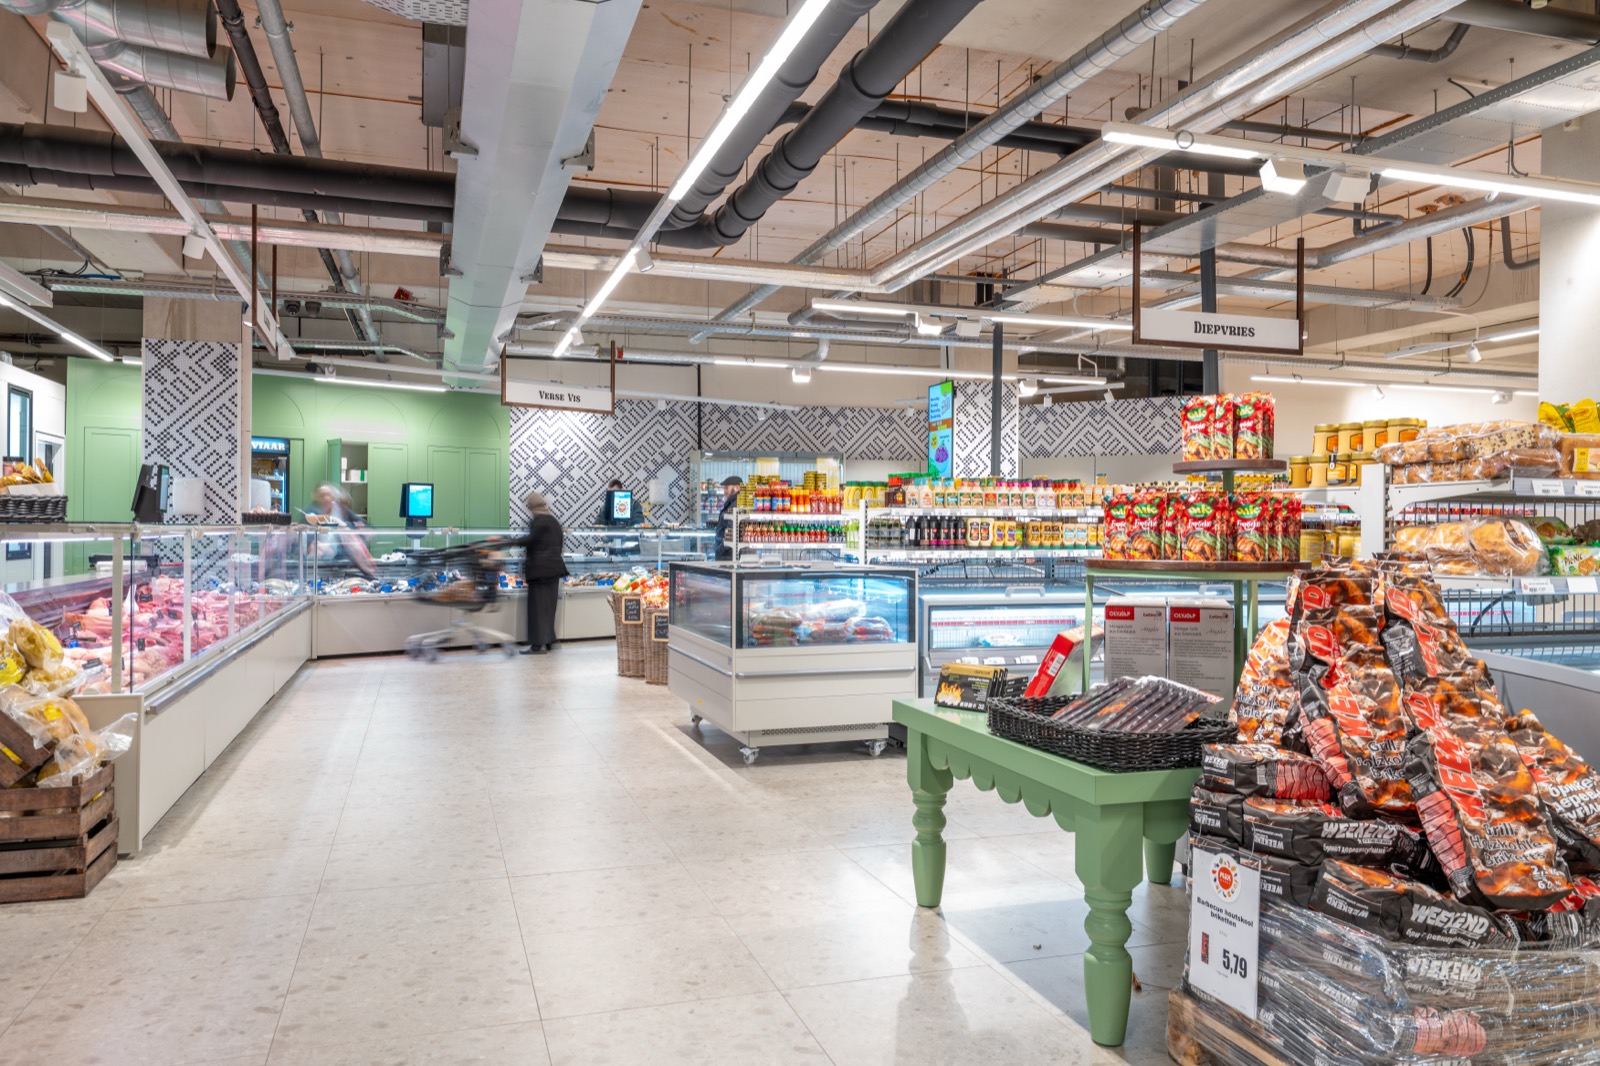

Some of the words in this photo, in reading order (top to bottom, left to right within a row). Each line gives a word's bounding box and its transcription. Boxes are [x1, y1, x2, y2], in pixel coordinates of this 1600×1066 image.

[1194, 321, 1255, 337] DIEPVRIES
[539, 390, 565, 401] VERSE
[567, 393, 581, 402] VIS
[1321, 822, 1398, 839] WEEKEND
[1197, 896, 1223, 915] Barbecue
[1224, 910, 1254, 928] houtskool
[1210, 911, 1237, 928] briketten
[1410, 904, 1490, 934] WEEKEND
[1222, 948, 1248, 979] 5,79
